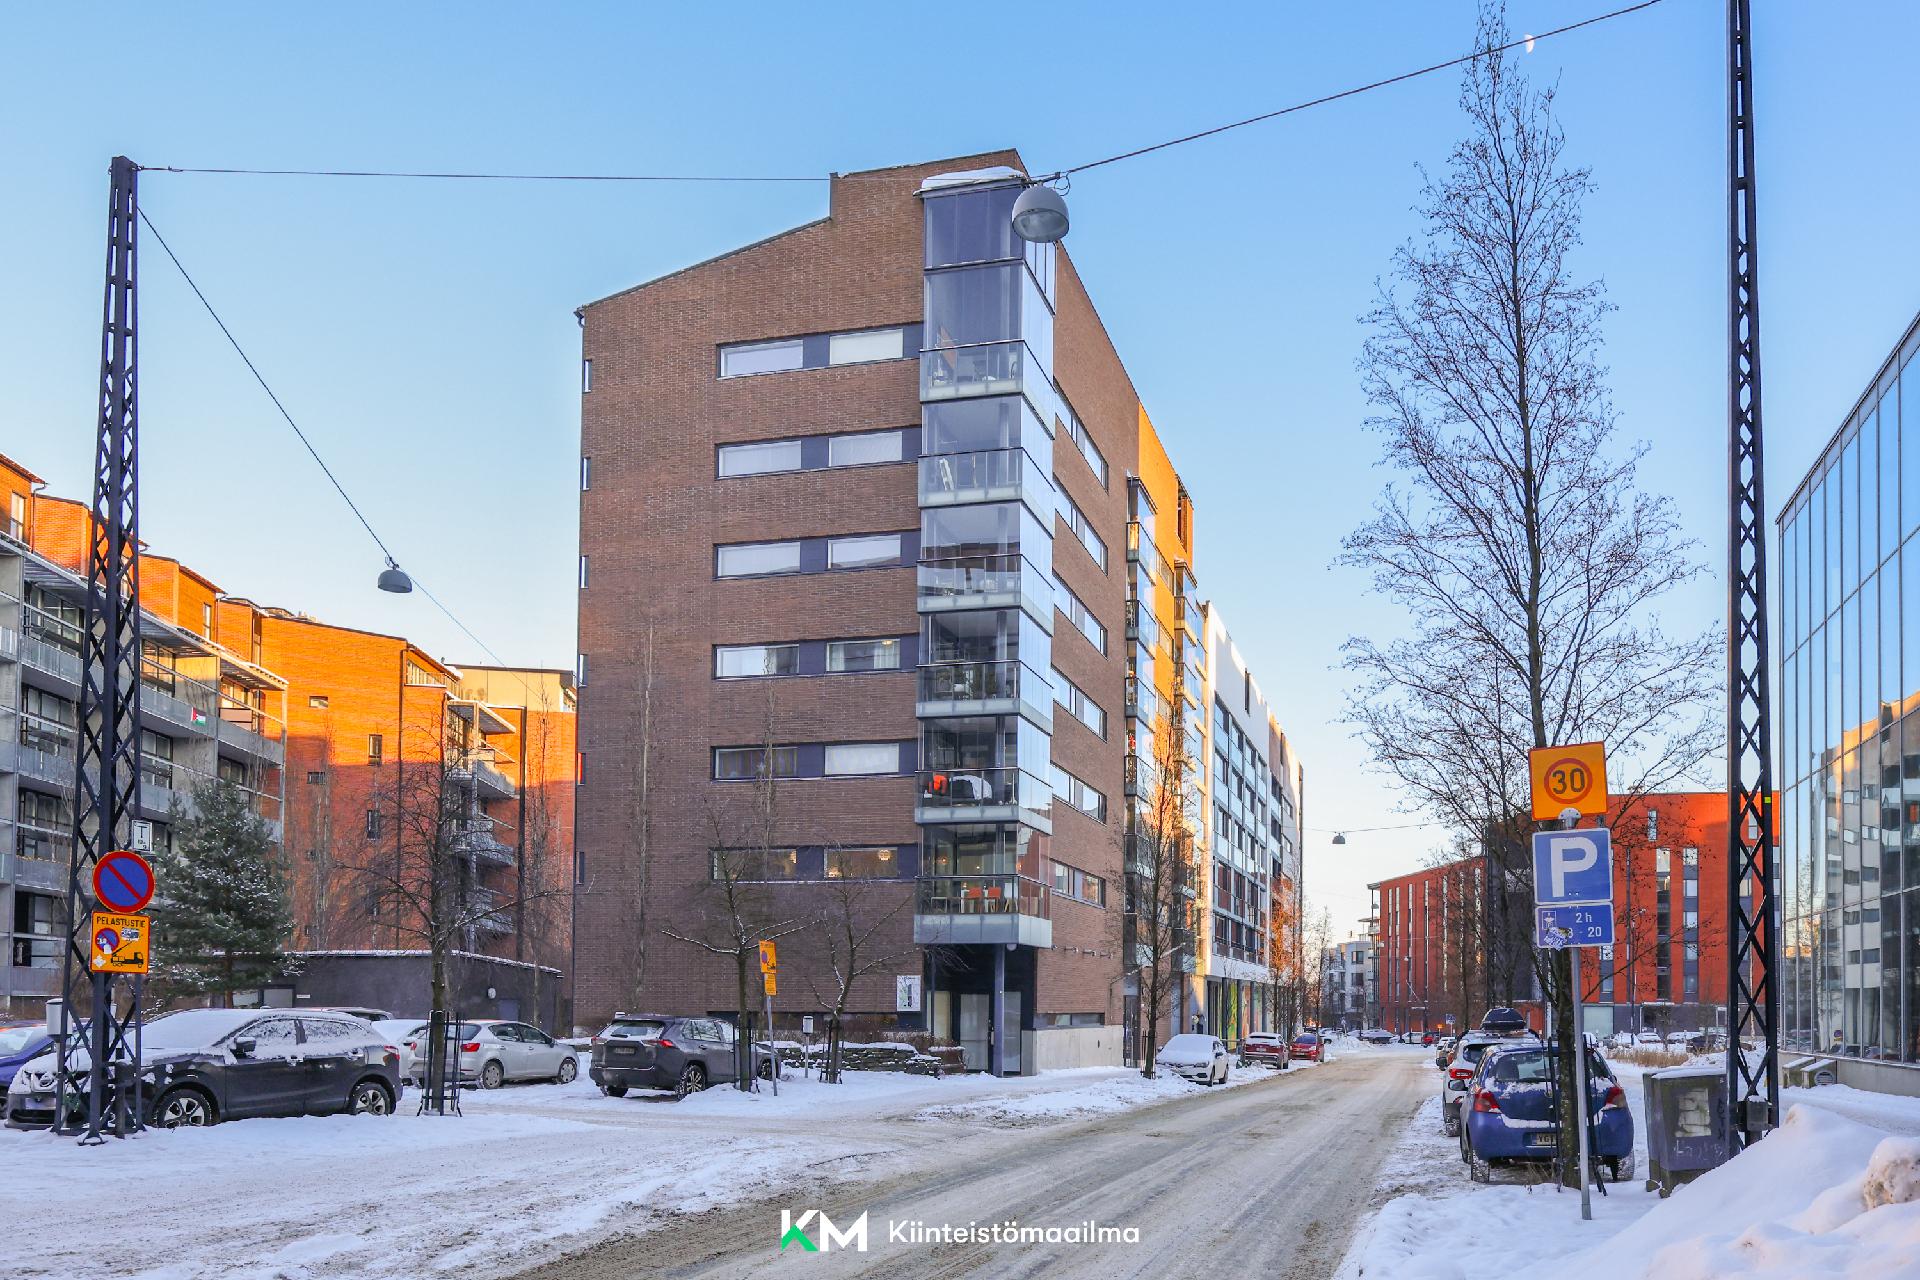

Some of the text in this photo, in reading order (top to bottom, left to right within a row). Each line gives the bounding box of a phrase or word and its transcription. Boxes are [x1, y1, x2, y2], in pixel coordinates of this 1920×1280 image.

[1551, 767, 1586, 795] 30
[1550, 836, 1598, 898] P
[96, 916, 146, 928] PELASTUSTIE
[1575, 912, 1593, 923] 2 h
[1587, 926, 1602, 938] 20
